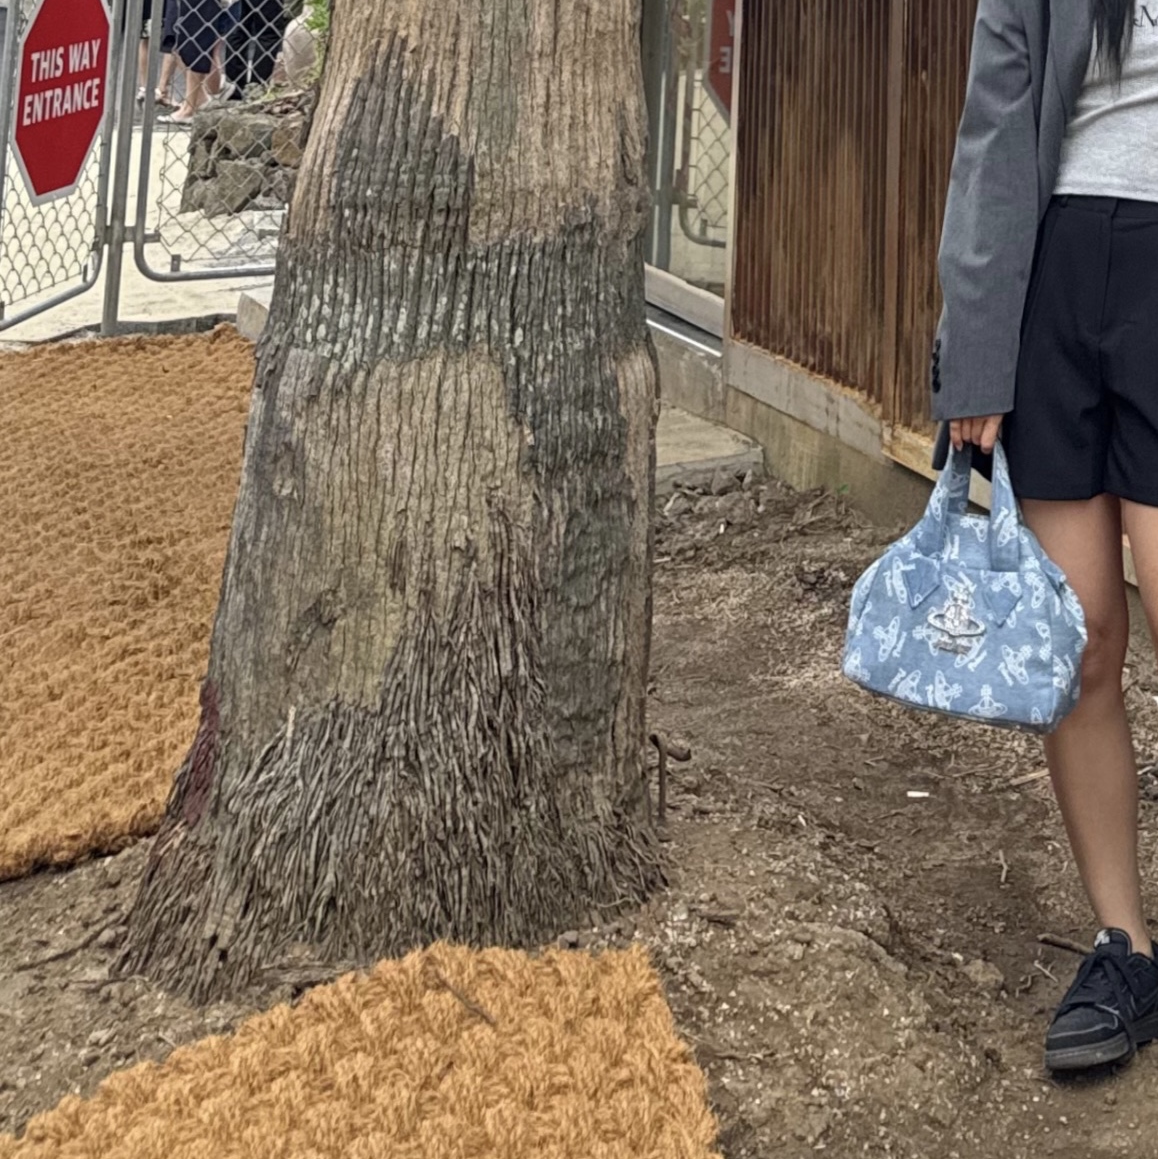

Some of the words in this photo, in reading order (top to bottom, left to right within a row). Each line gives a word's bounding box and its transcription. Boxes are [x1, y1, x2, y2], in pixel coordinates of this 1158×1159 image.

[31, 45, 65, 83] THIS
[68, 37, 101, 74] WAY
[22, 77, 101, 127] ENTRANCE
